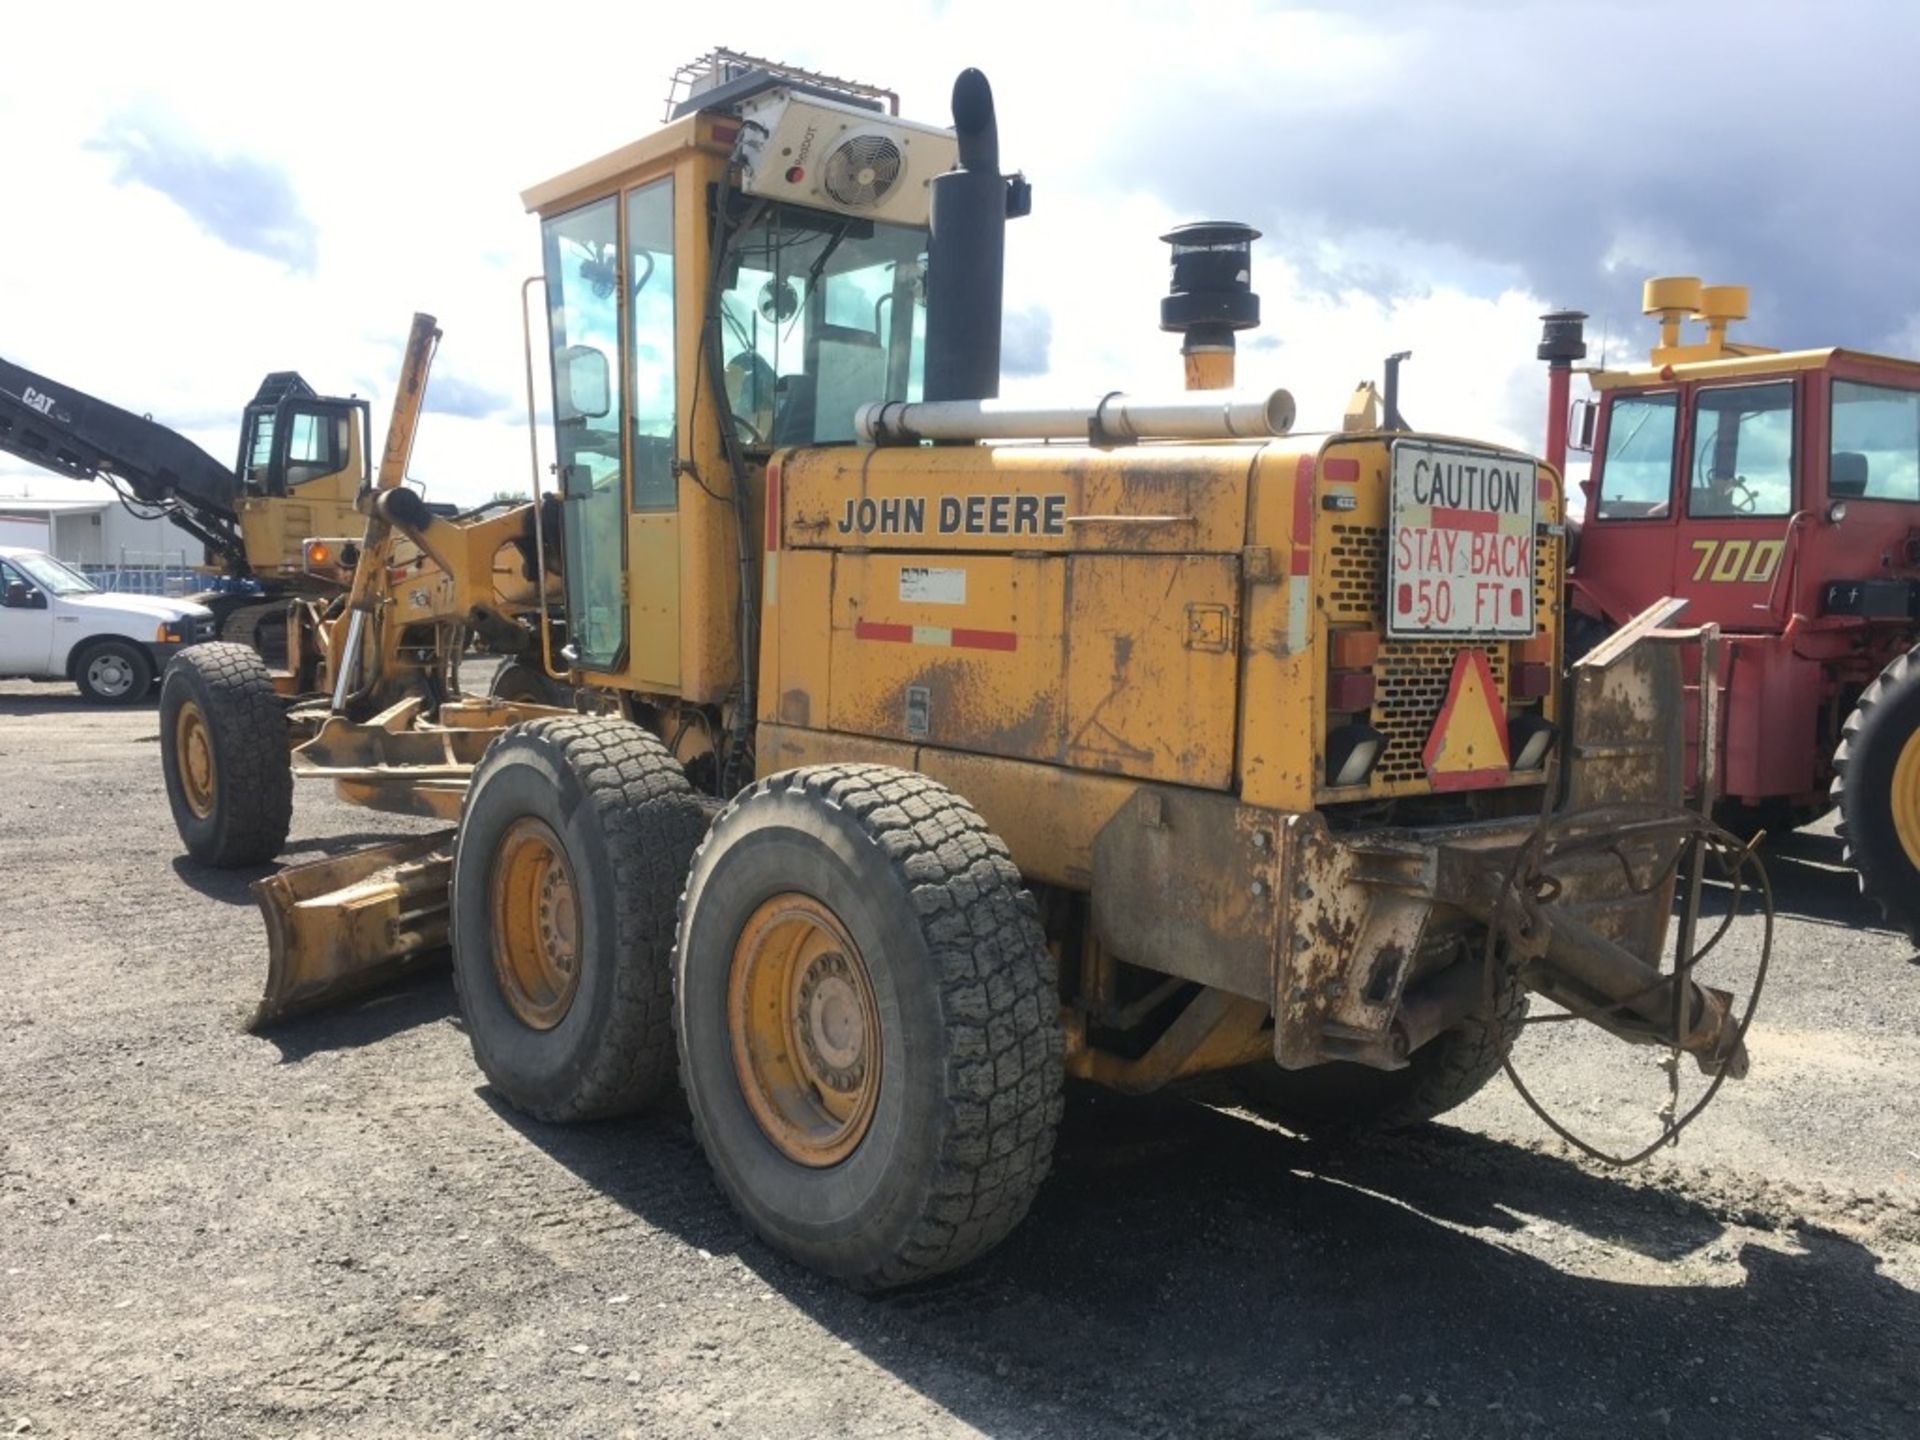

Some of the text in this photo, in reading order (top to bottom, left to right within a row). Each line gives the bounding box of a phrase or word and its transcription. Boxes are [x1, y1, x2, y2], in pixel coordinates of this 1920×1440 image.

[23, 387, 56, 414] CAT
[1414, 460, 1520, 513] CAUTION
[838, 495, 1067, 535] JOHN DEERE
[1398, 527, 1530, 578] STAY BACK
[1691, 539, 1786, 581] 700
[1417, 579, 1504, 625] 50 FT
